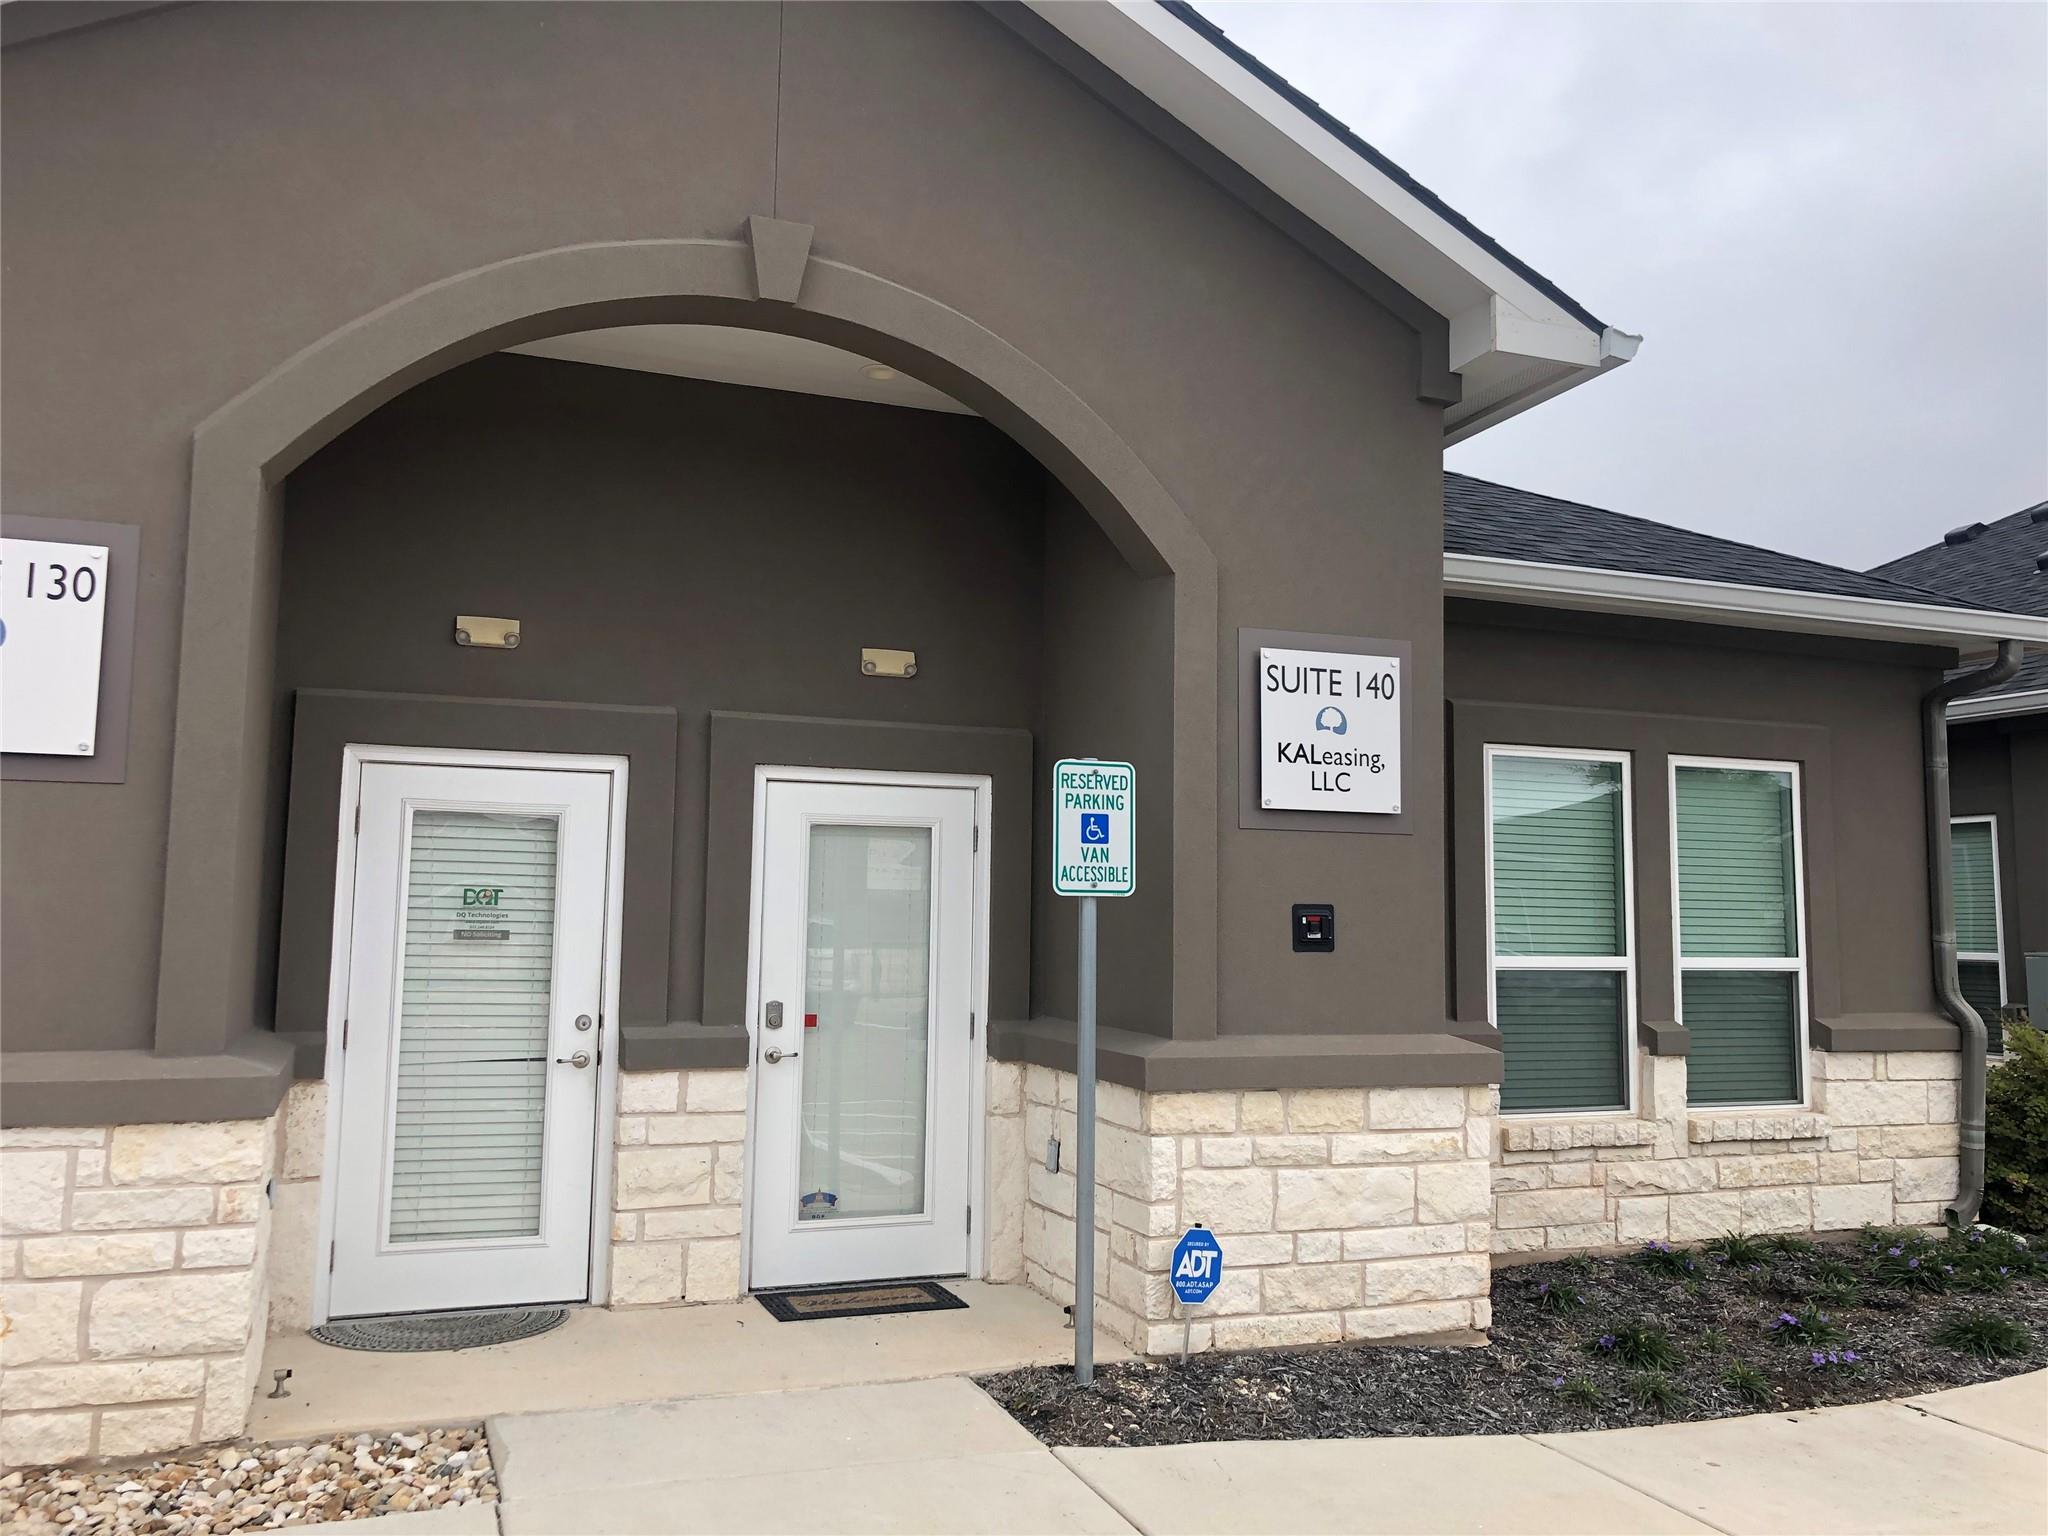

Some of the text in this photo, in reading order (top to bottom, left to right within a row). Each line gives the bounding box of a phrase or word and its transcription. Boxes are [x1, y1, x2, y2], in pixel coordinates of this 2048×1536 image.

[26, 562, 97, 603] 130
[1266, 664, 1395, 701] SUITE 140
[1277, 742, 1386, 774] KALeasing,
[1061, 772, 1129, 791] RESERVED
[1311, 770, 1351, 793] LLC
[1065, 792, 1125, 811] PARKING
[1080, 846, 1110, 864] VAN
[1060, 865, 1129, 883] ACCESSIBLE
[1175, 1249, 1218, 1279] ADT
